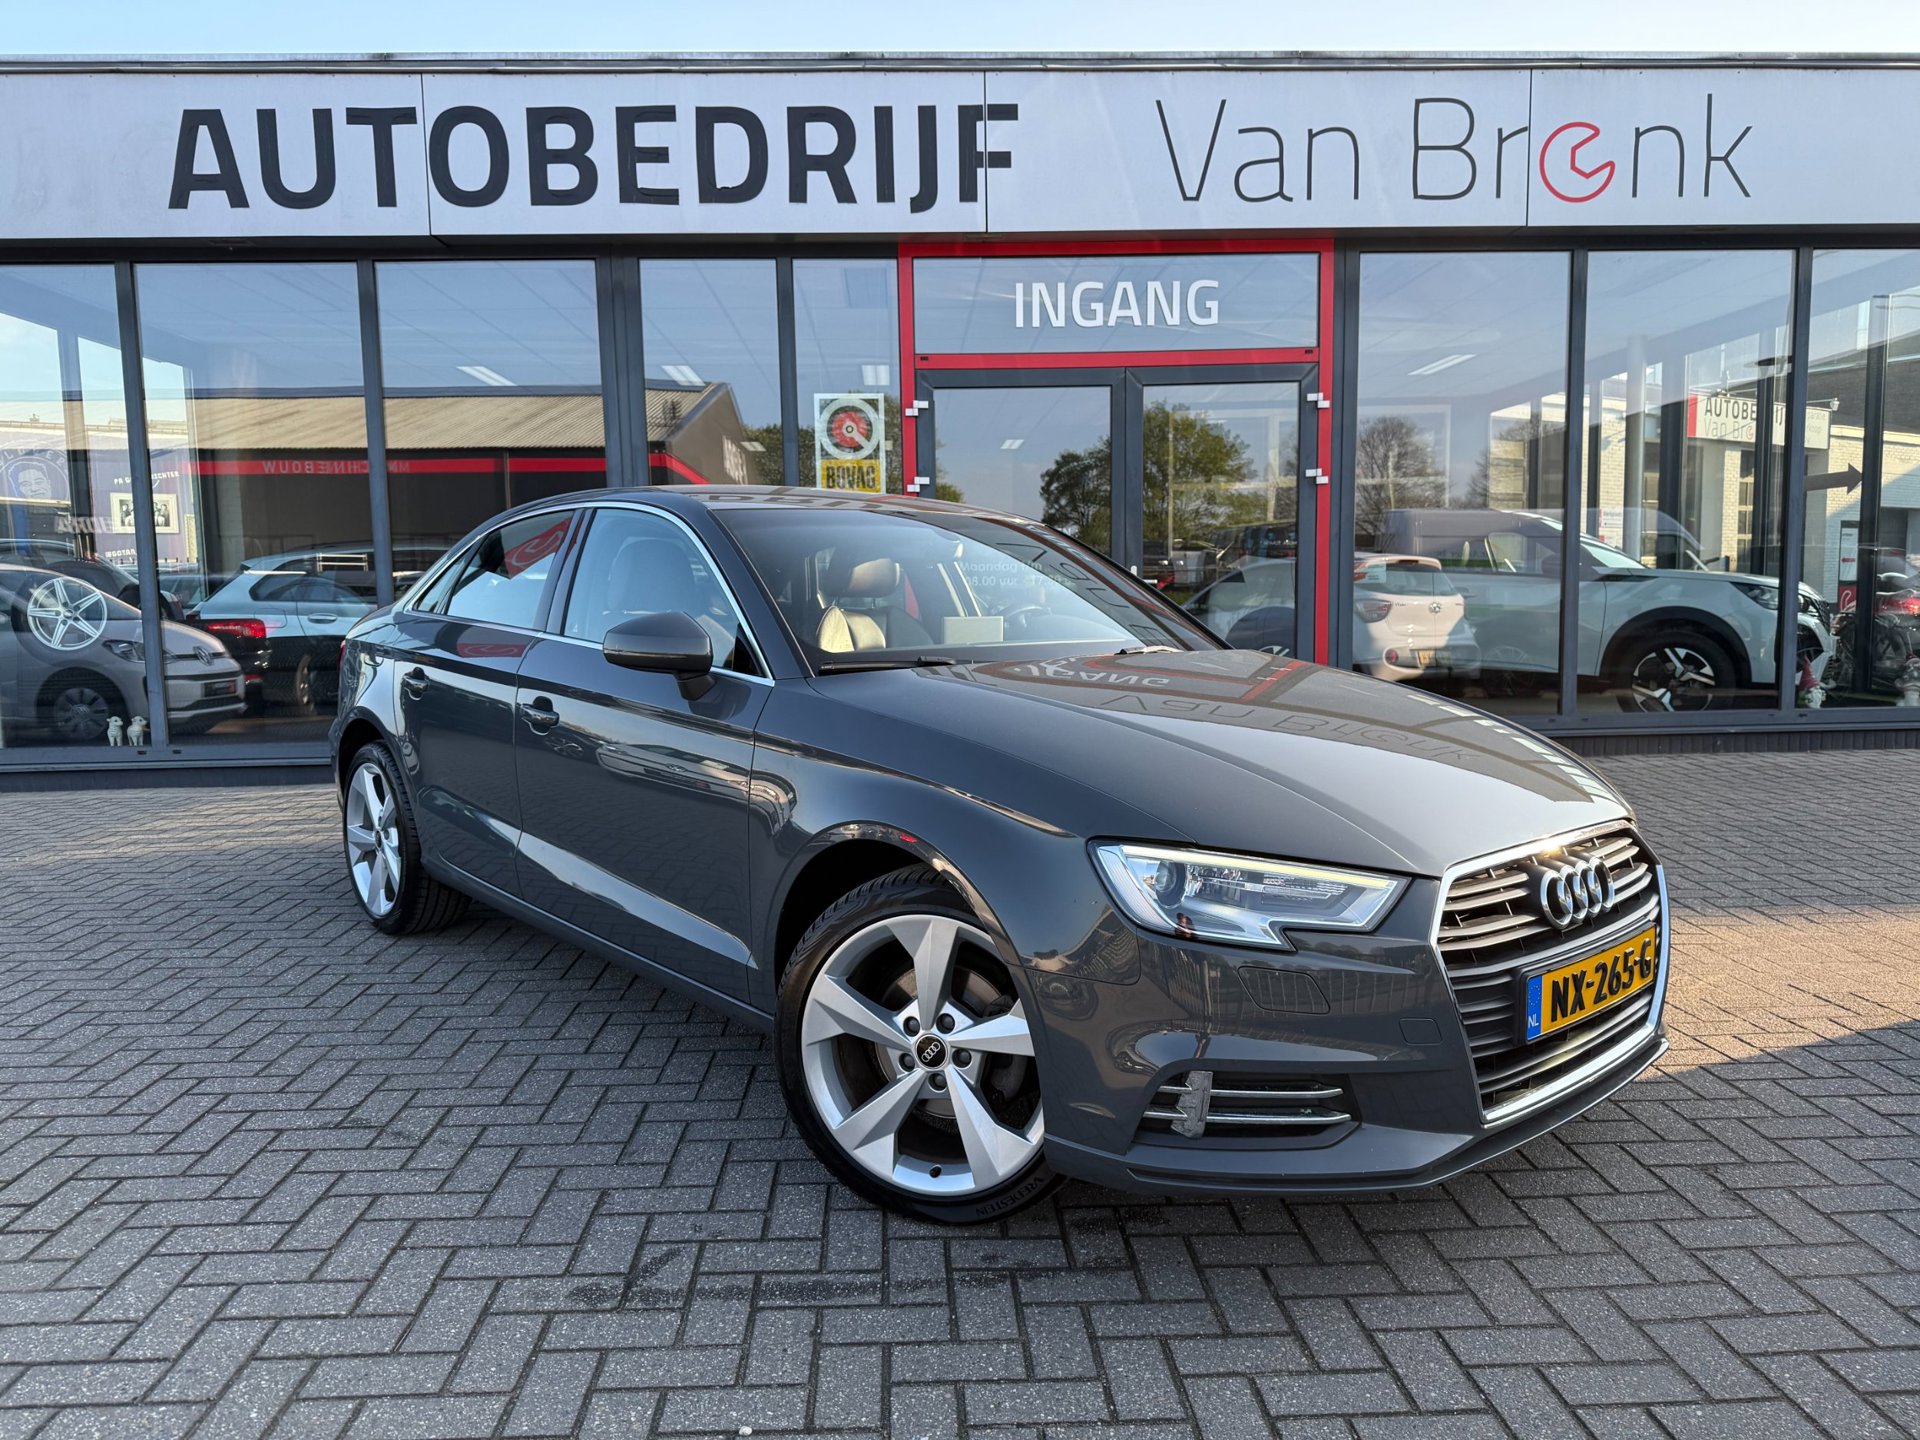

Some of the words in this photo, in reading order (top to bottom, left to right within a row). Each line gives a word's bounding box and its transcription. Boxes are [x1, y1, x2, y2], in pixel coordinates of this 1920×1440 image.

[168, 103, 1019, 214] AUTOBEDRIJF
[1156, 99, 1361, 202] Van
[1014, 278, 1221, 328] INGANG
[826, 465, 876, 488] BOVAG
[958, 560, 1018, 573] Maandag
[1551, 937, 1652, 1023] NX-265-G
[1527, 1013, 1540, 1029] NL
[976, 1177, 1044, 1217] VREDESTEIN
